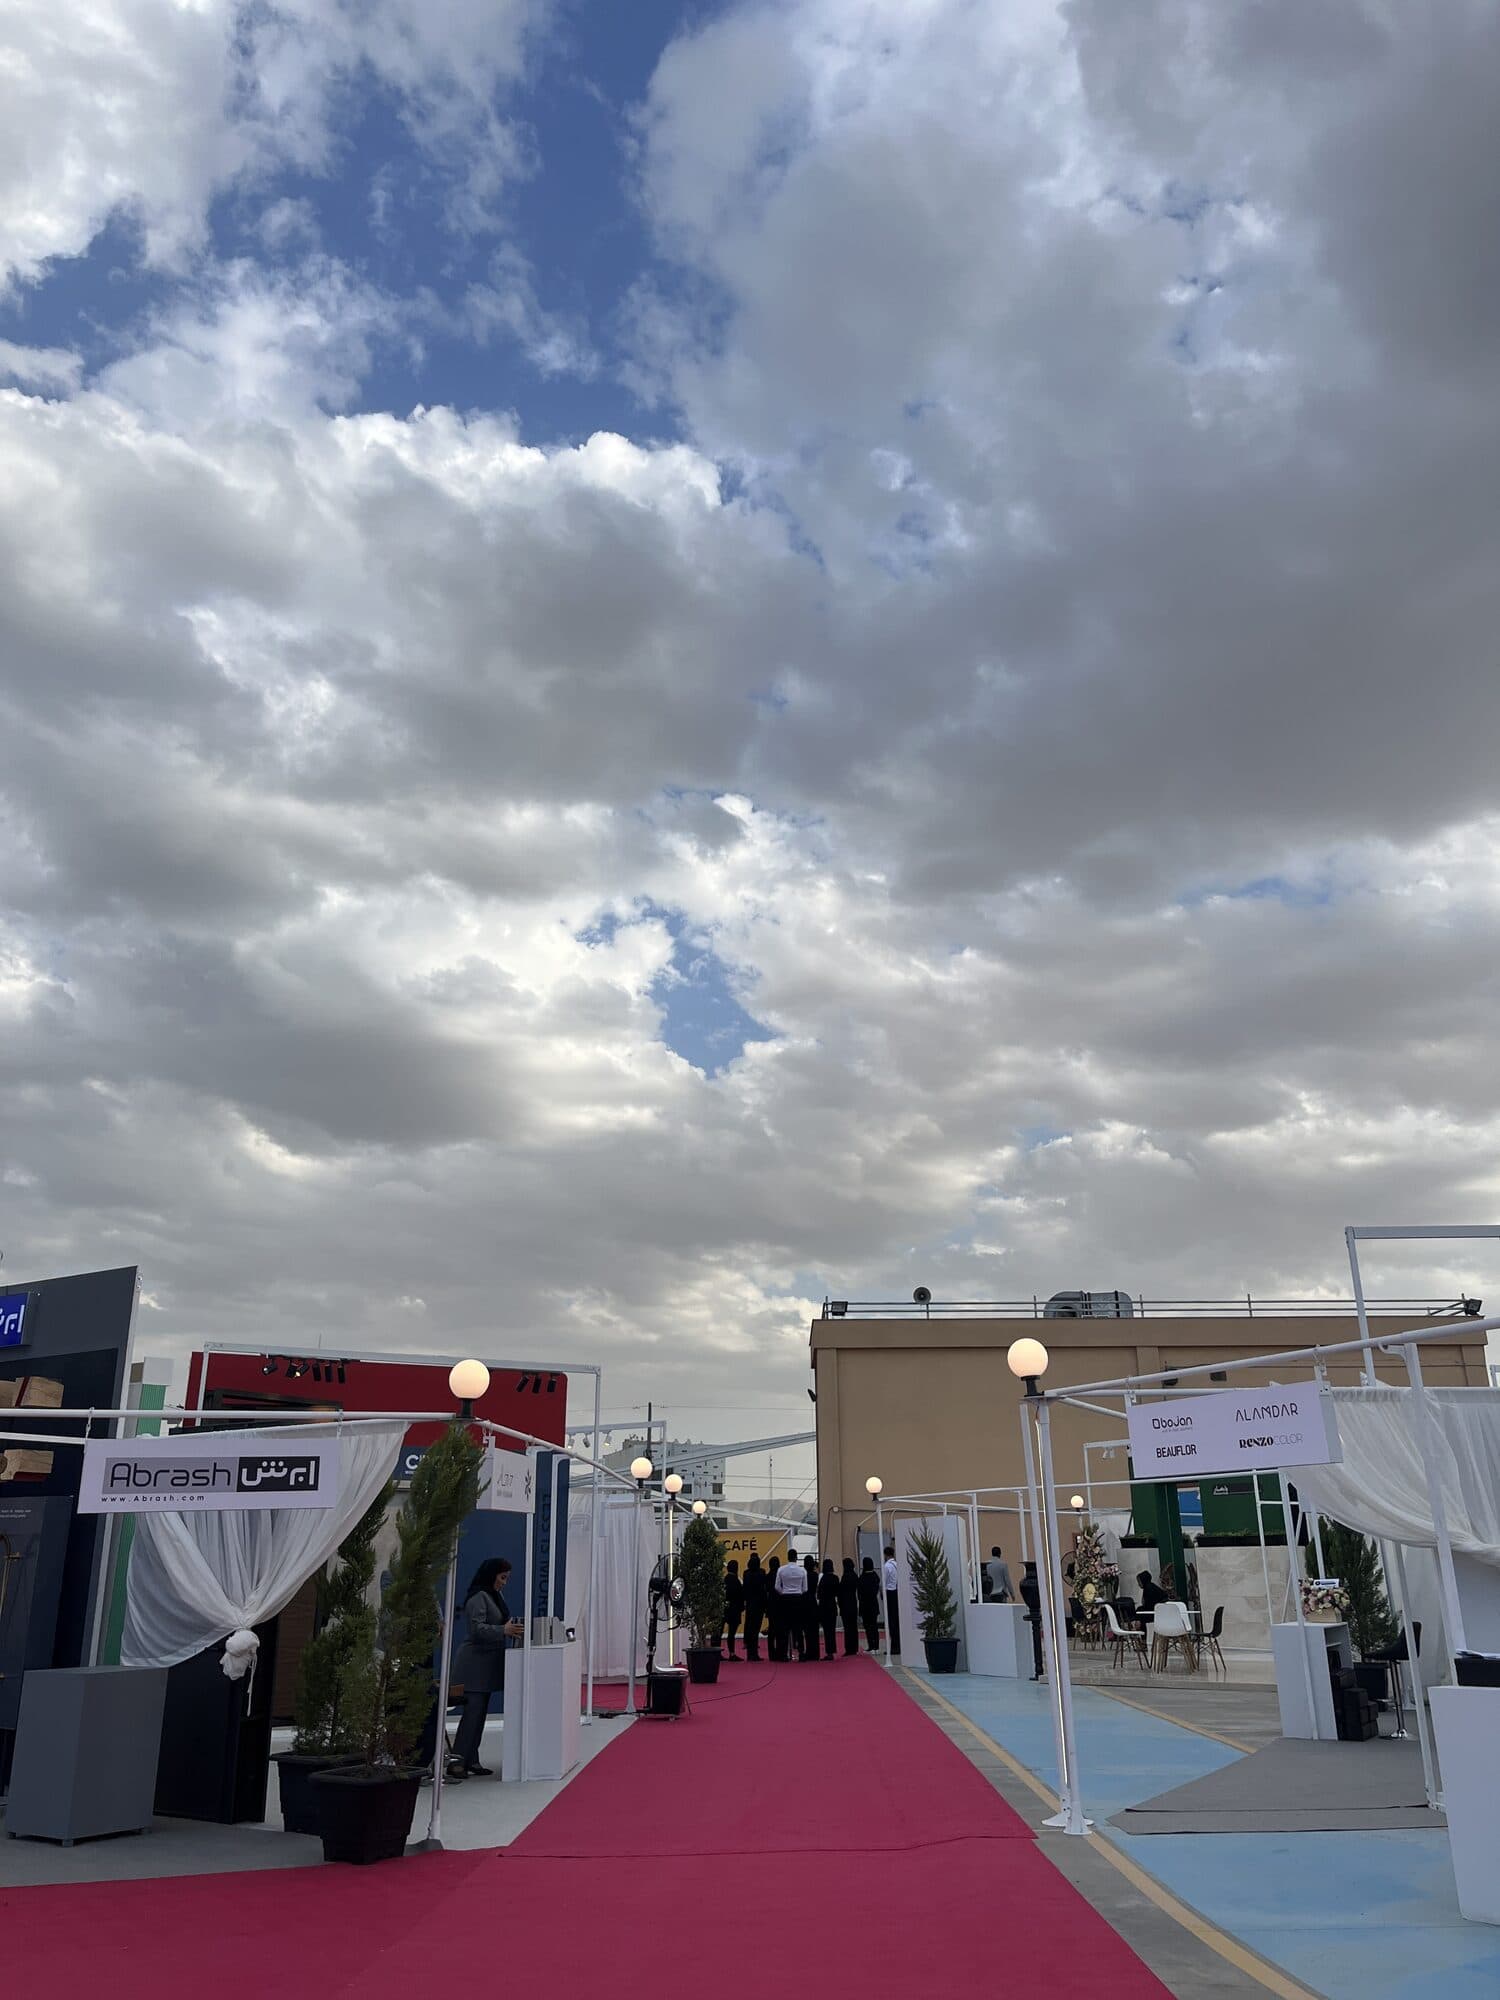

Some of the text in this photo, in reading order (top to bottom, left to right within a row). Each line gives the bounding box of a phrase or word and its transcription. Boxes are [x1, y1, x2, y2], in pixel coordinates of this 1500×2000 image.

[1156, 1443, 1198, 1459] BEAUFLOR
[110, 1461, 231, 1488] Abrash
[241, 1460, 316, 1487] ابرش
[101, 1494, 205, 1503] www.Abrash.com
[723, 1537, 757, 1551] CAFÉ
